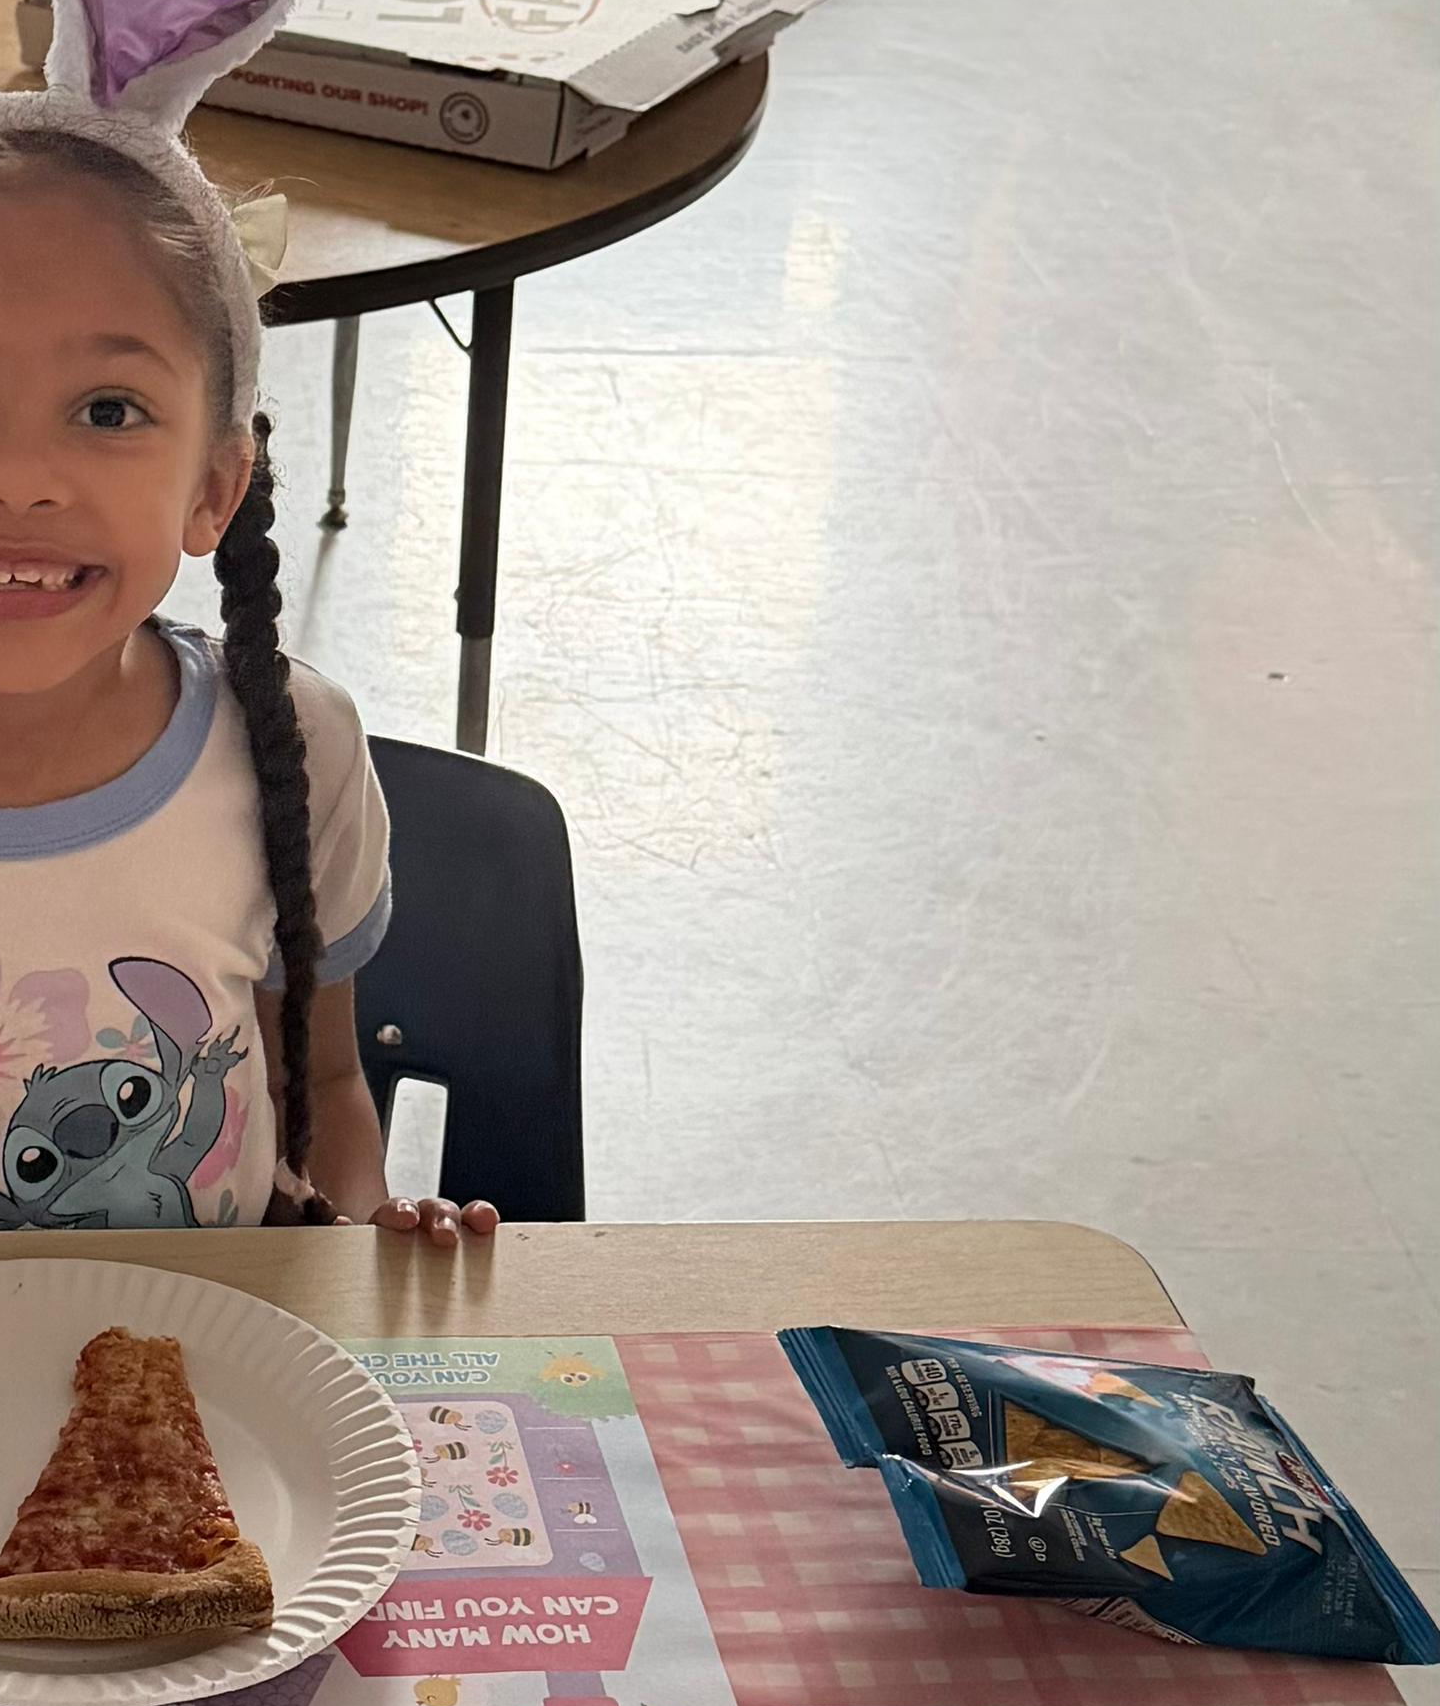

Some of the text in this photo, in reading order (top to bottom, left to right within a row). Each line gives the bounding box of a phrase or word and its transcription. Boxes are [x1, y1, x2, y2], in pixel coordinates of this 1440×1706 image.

[321, 84, 361, 101] OUR
[367, 92, 429, 115] SHOP!
[394, 1354, 446, 1367] THE
[452, 1353, 499, 1366] ALL
[921, 1361, 944, 1379] 140
[375, 1370, 489, 1385] CAN YOU
[1229, 1466, 1281, 1547] FLAVORED
[983, 1510, 1006, 1525] OZ
[987, 1526, 1017, 1558] (28g)
[455, 1597, 535, 1618] YOU
[542, 1595, 620, 1616] CAN
[382, 1623, 592, 1649] HOW MANY
